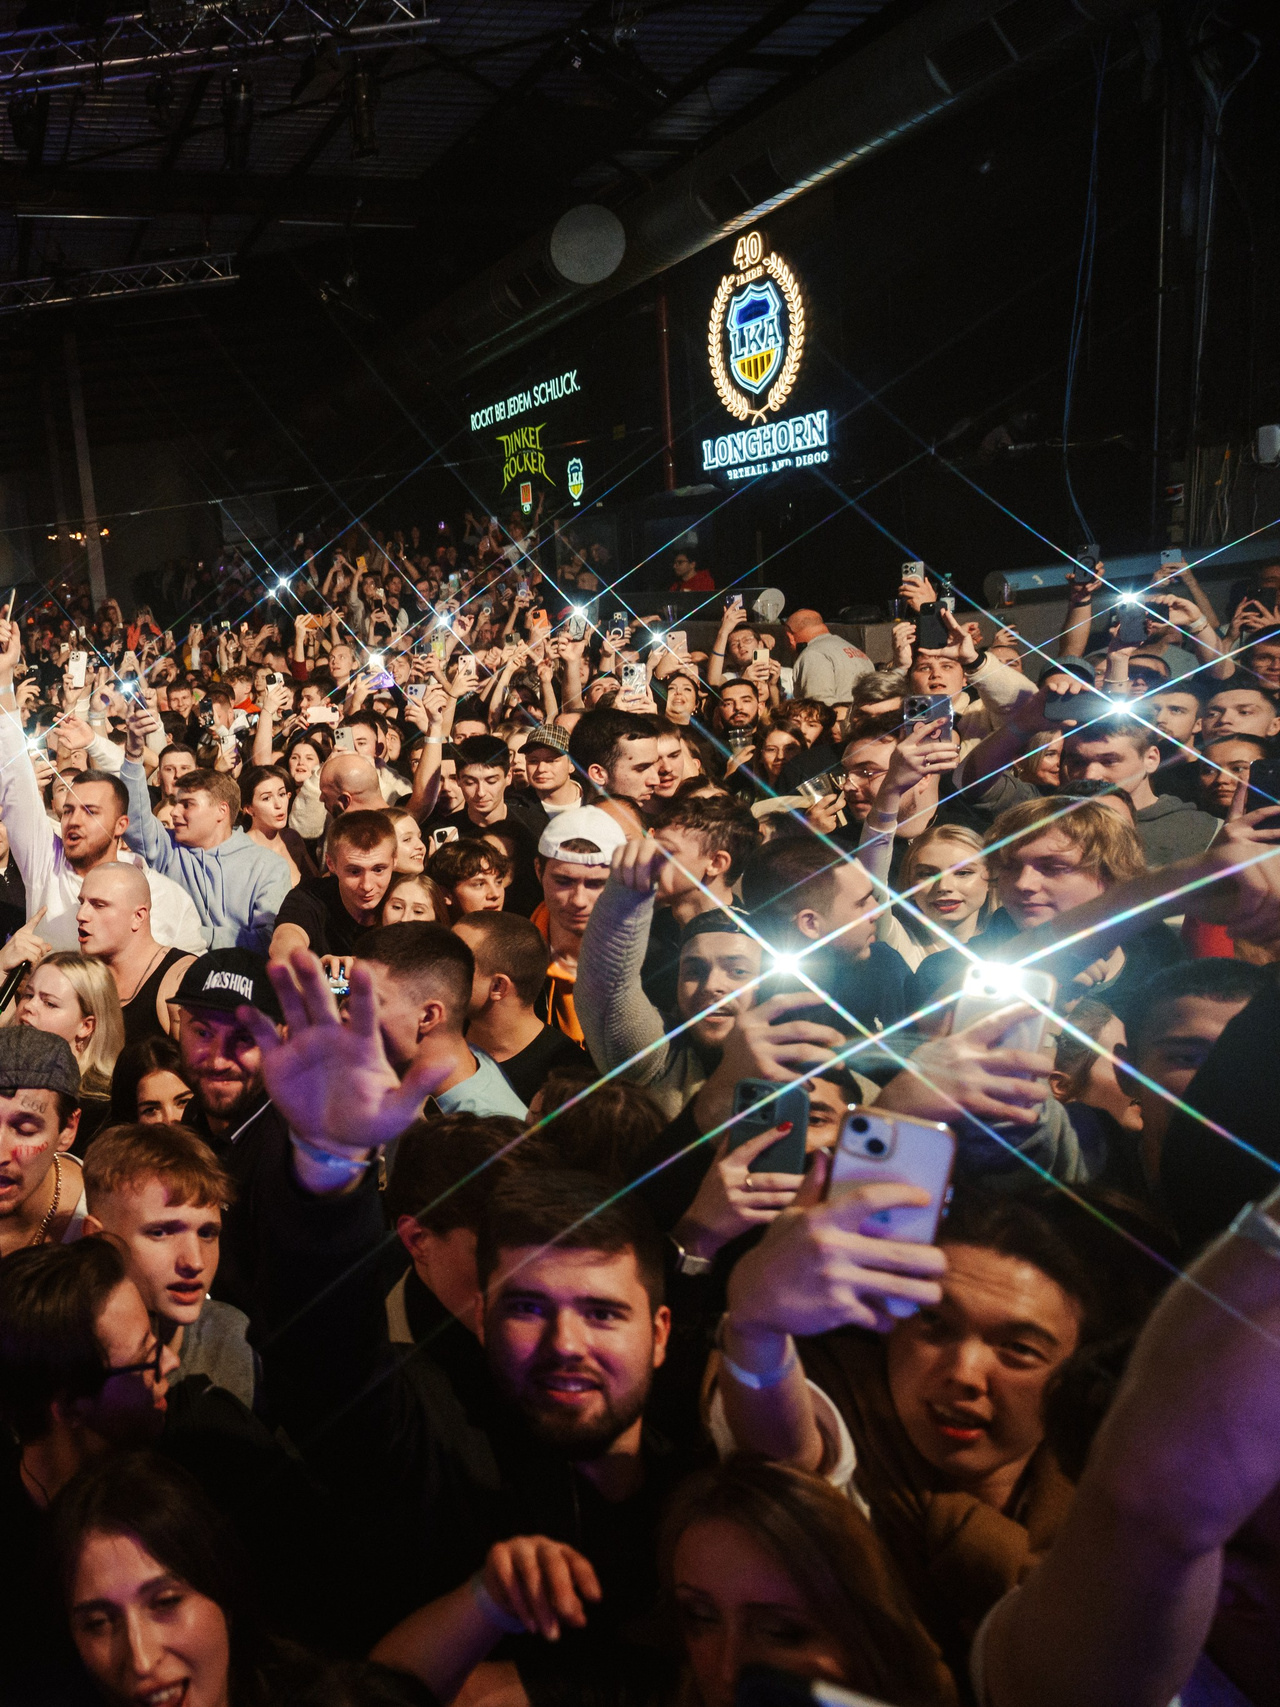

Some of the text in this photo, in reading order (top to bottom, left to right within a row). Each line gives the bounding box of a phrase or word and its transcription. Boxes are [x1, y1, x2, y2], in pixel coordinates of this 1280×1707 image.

[733, 231, 762, 270] 40
[736, 265, 763, 287] JAHRE
[730, 315, 783, 361] LKA
[470, 369, 581, 431] ROCKT BEI JEDEM SCHLUCK.
[496, 422, 547, 458] DINKEL
[703, 410, 828, 471] LONGHORN
[500, 452, 557, 495] ROCKER
[568, 471, 584, 487] LKA
[771, 458, 793, 472] AND
